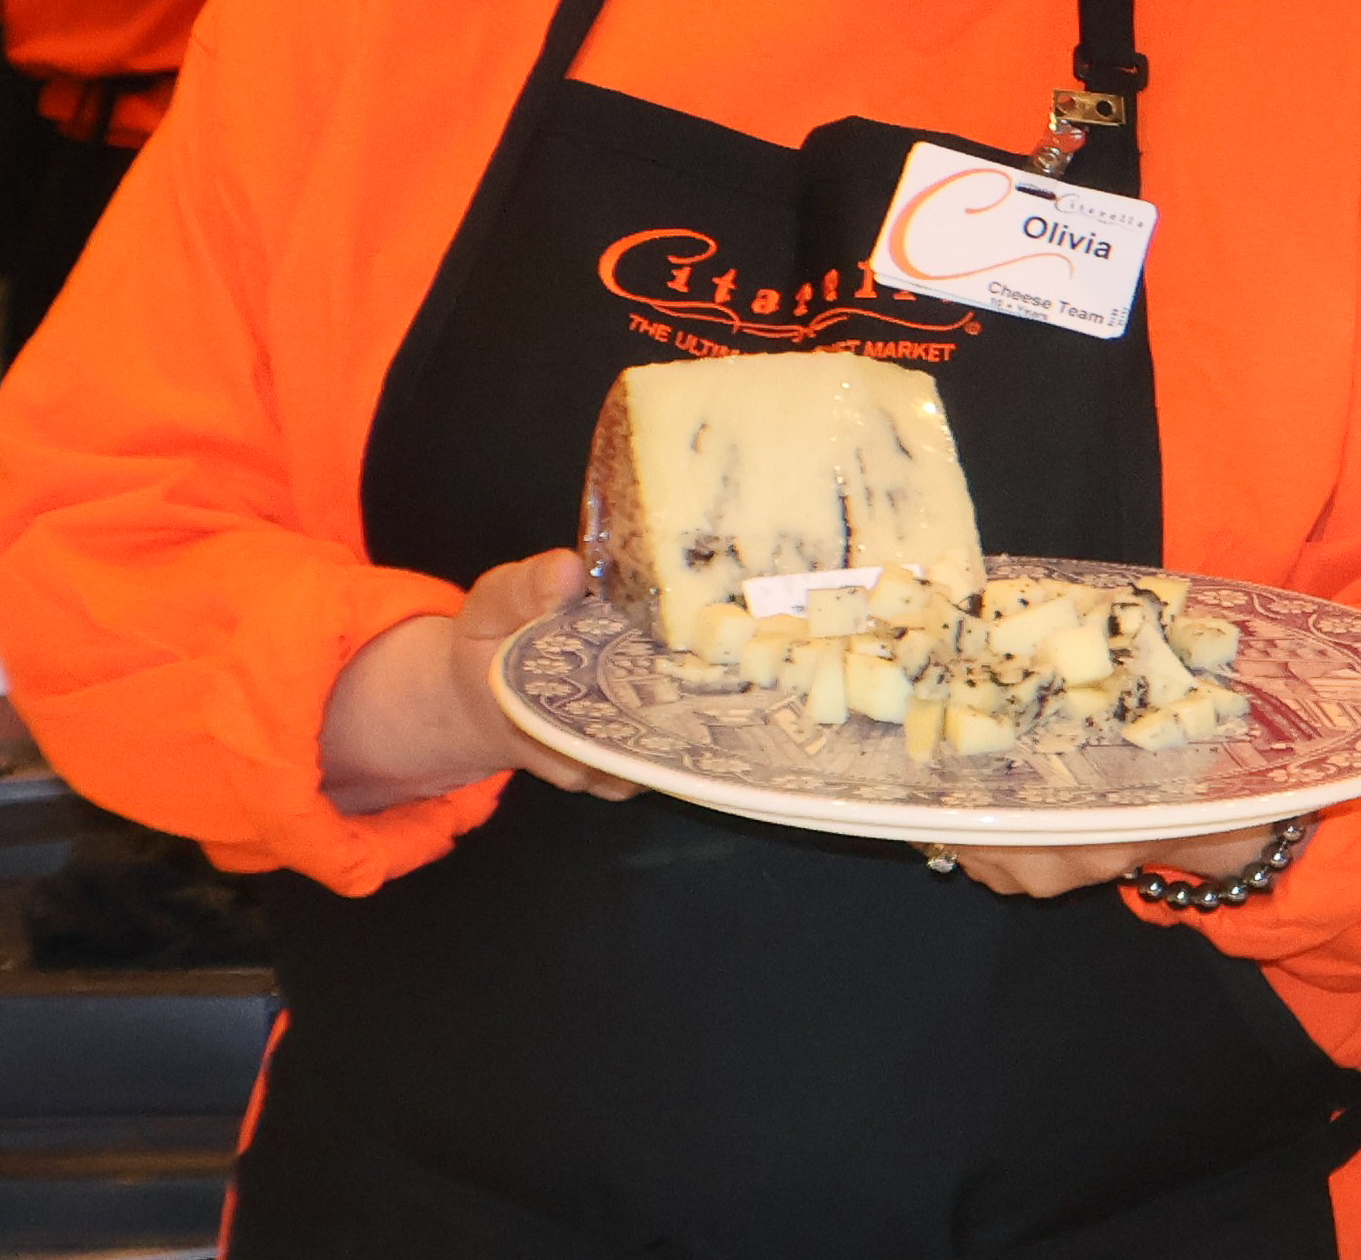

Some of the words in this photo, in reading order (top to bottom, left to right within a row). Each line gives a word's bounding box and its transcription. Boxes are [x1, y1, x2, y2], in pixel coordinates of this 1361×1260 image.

[1054, 192, 1146, 229] Citarella
[1022, 215, 1113, 260] Olivia
[987, 280, 1053, 311] Cheese
[1058, 299, 1106, 326] Team
[628, 312, 672, 343] THE
[862, 340, 956, 363] MARKET
